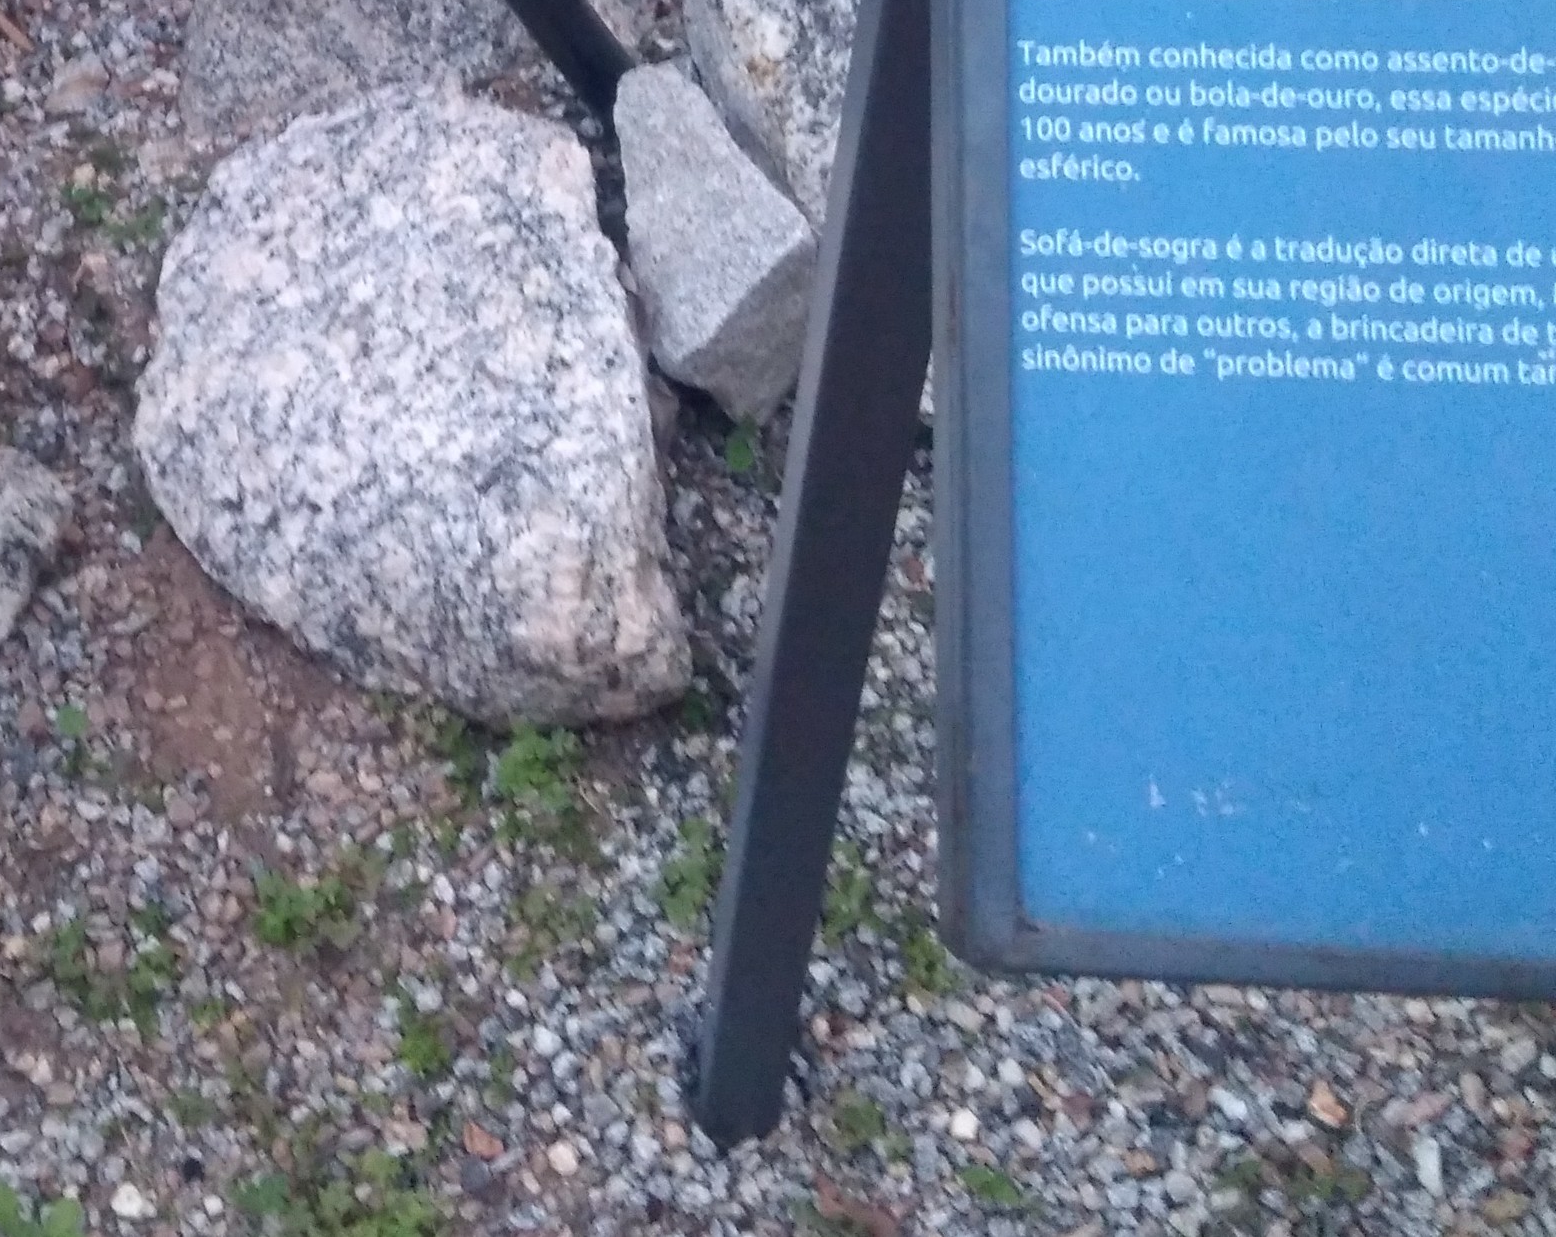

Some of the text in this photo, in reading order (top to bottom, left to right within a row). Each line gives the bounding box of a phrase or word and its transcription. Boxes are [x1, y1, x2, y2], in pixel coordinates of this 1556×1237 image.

[1017, 39, 1141, 68] Também
[1148, 41, 1292, 71] conhecida
[1300, 50, 1379, 72] como
[1018, 78, 1556, 117] dourado ou bola-de-ouro, essa espéci
[1020, 116, 1556, 152] 100 anos e é famosa pelo seu tamanh
[1019, 153, 1141, 182] esférico.
[1019, 228, 1218, 263] Sofá-de-sogra
[1226, 233, 1243, 261] é
[1251, 240, 1266, 261] a
[1274, 236, 1404, 269] tradução
[1411, 237, 1498, 266] direta
[1505, 239, 1543, 267] de
[1021, 272, 1075, 297] que
[1082, 271, 1173, 298] possui
[1181, 278, 1225, 299] em
[1232, 279, 1282, 300] sua
[1289, 274, 1381, 307] região
[1388, 277, 1425, 303] de
[1433, 279, 1545, 312] origem,
[1021, 305, 1118, 335] ofensa
[1126, 314, 1189, 338] para
[1196, 311, 1300, 344] outros,
[1307, 318, 1323, 339] a
[1331, 312, 1493, 345] brincadeira
[1501, 317, 1539, 346] de
[1021, 343, 1152, 373] sinônimo
[1159, 347, 1195, 374] de
[1203, 349, 1370, 381] "problema"
[1377, 354, 1395, 382] é
[1402, 361, 1509, 385] comum
